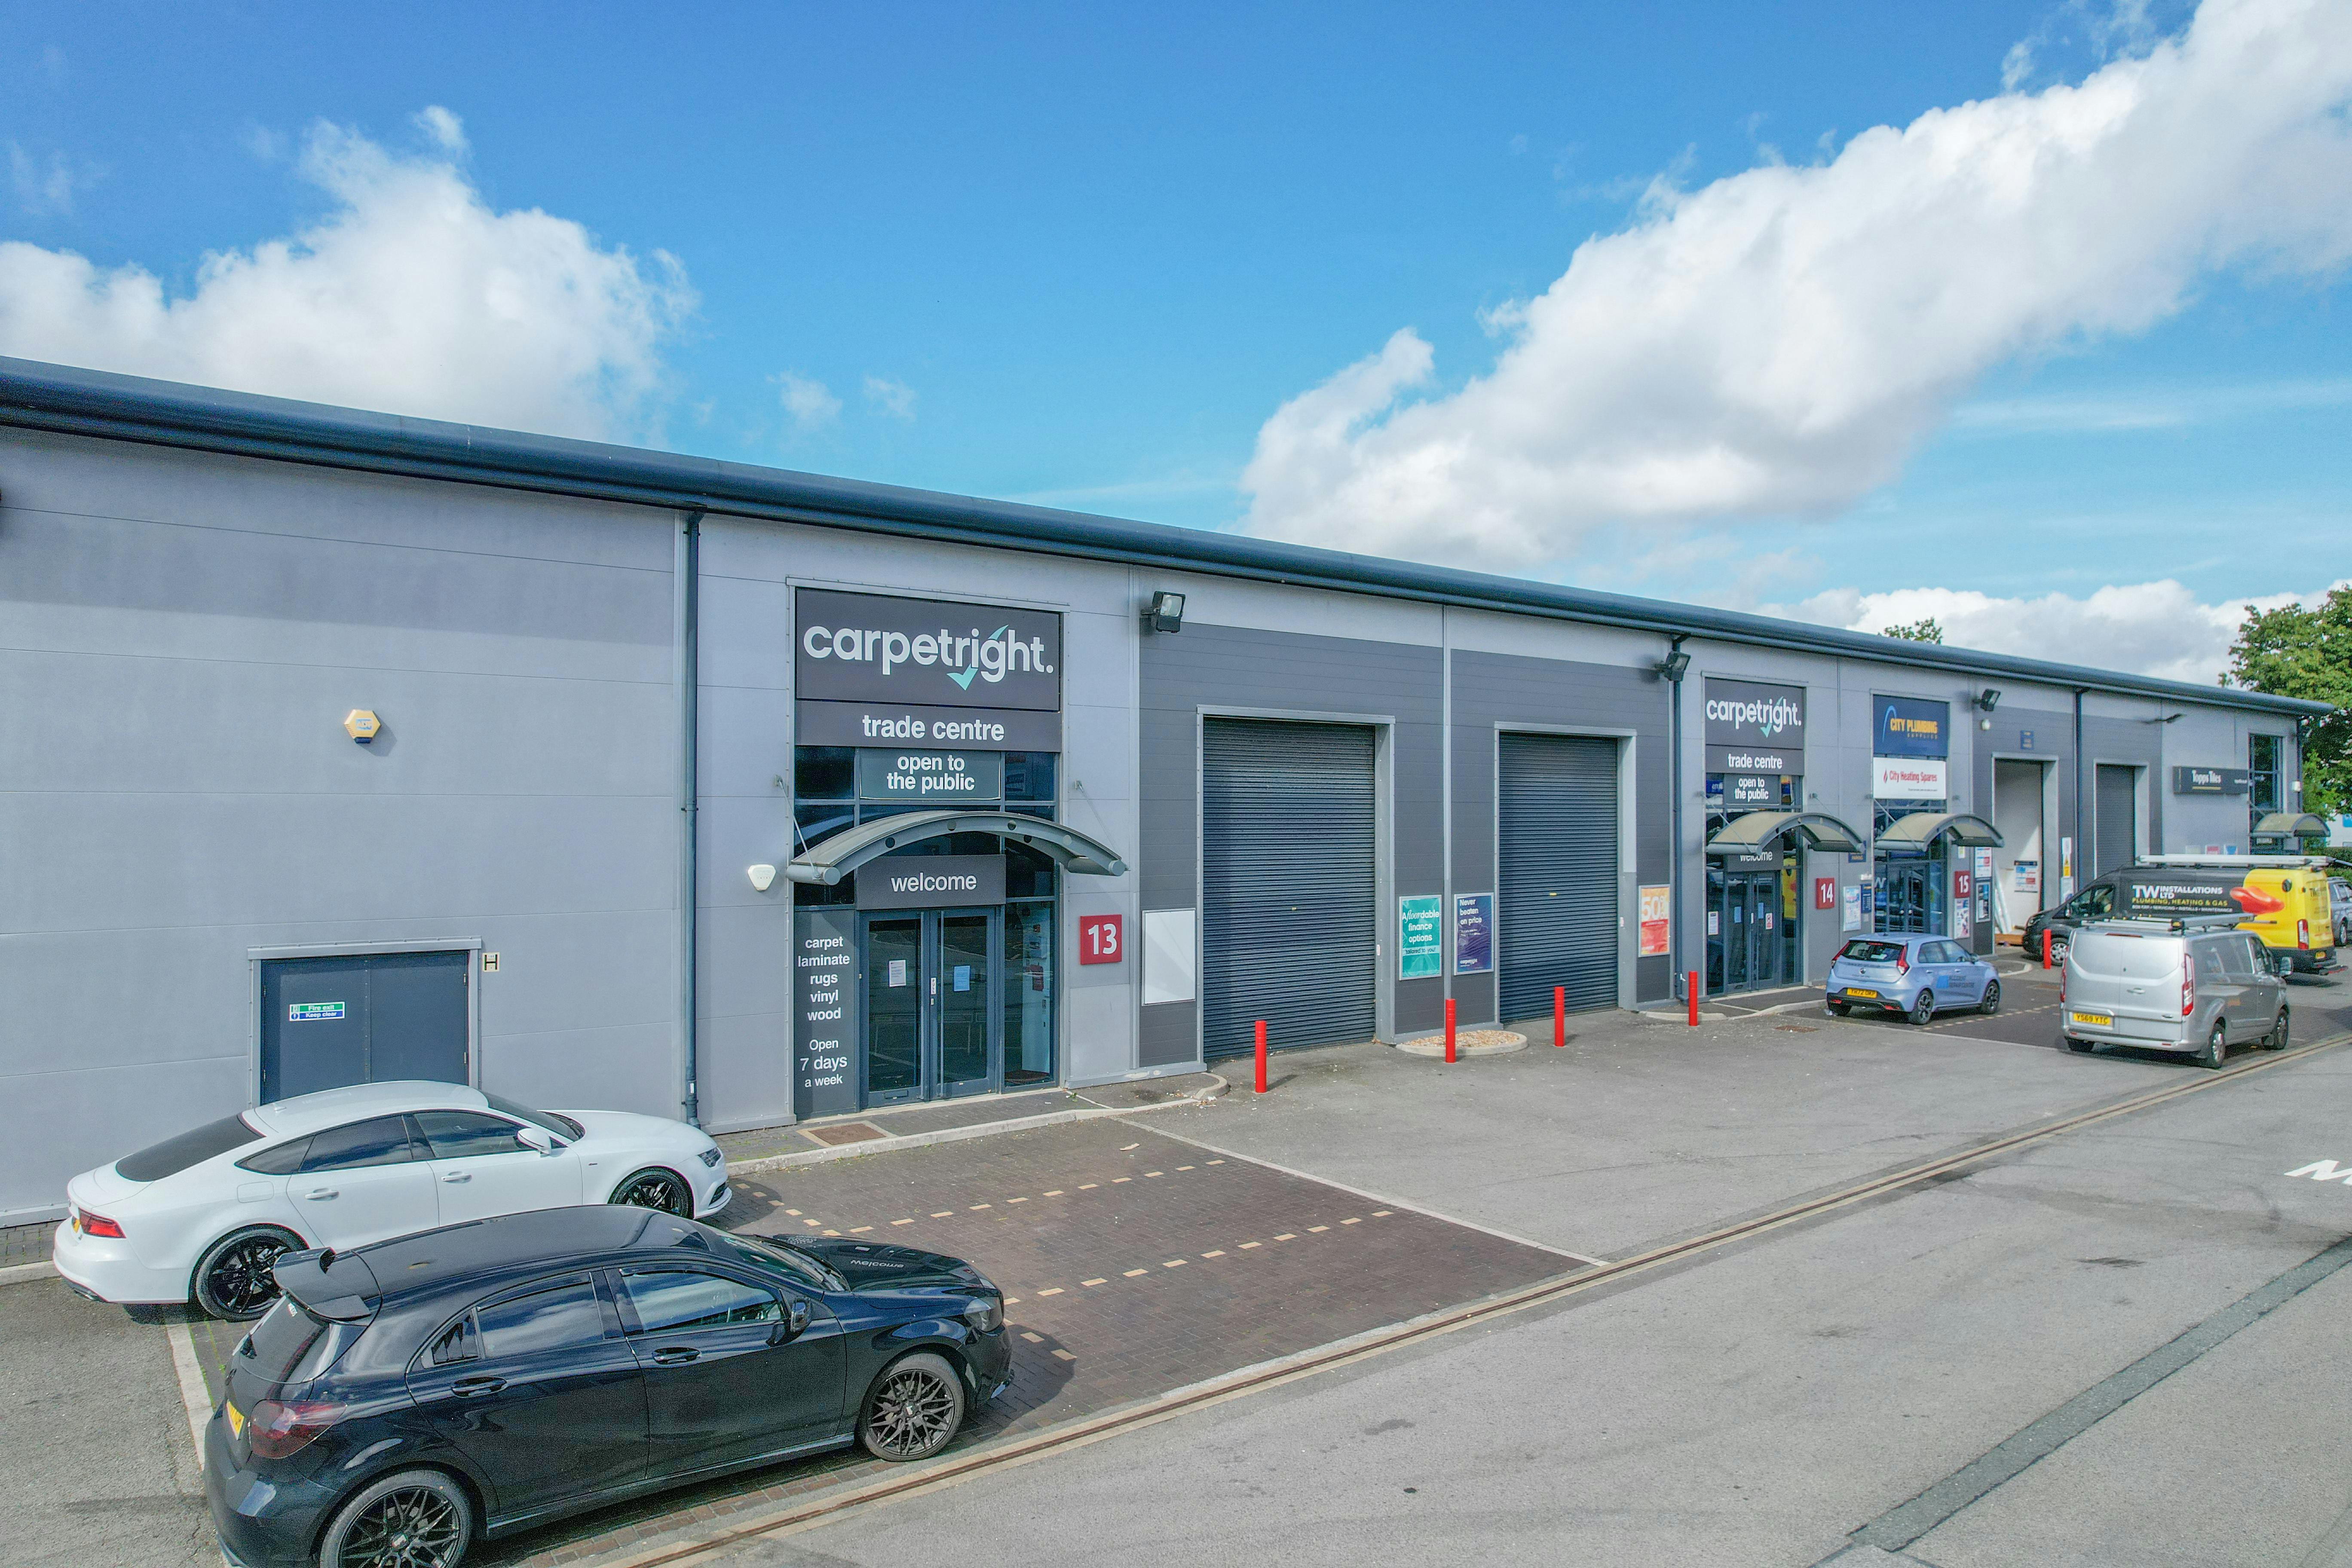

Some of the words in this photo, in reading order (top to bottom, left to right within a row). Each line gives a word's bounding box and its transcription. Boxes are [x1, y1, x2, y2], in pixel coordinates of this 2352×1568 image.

[862, 715, 925, 738] trade
[933, 720, 1004, 741] centre
[1890, 718, 1905, 731] CITY
[1907, 720, 1938, 734] PLUMBING
[897, 755, 942, 774] open
[948, 755, 965, 771] to
[1728, 753, 1752, 768] trade
[1755, 755, 1782, 769] centre
[887, 772, 916, 790] the
[922, 773, 974, 793] public
[1738, 778, 1756, 790] open
[1758, 777, 1765, 787] to
[1890, 770, 1899, 782] City
[1901, 771, 1919, 784] Heating
[1920, 772, 1937, 783] Spares
[1735, 789, 1746, 799] the
[1748, 789, 1769, 802] public
[891, 872, 977, 892] welcome
[1959, 875, 1969, 894] 15
[1821, 883, 1833, 903] 14
[2132, 885, 2160, 898] TW
[2160, 885, 2223, 894] INSTALLATIONS
[1468, 916, 1482, 925] price
[805, 936, 843, 950] carpet
[1088, 924, 1116, 954] 13
[1409, 934, 1433, 944] options
[484, 954, 497, 970] H
[798, 954, 850, 967] laminate
[810, 972, 838, 986] rugs
[810, 989, 839, 1004] vinyl
[807, 1008, 841, 1021] wood
[809, 1038, 839, 1053] Open
[800, 1058, 808, 1071] 7
[814, 1056, 847, 1072] days
[805, 1079, 812, 1087] a
[815, 1075, 842, 1087] week
